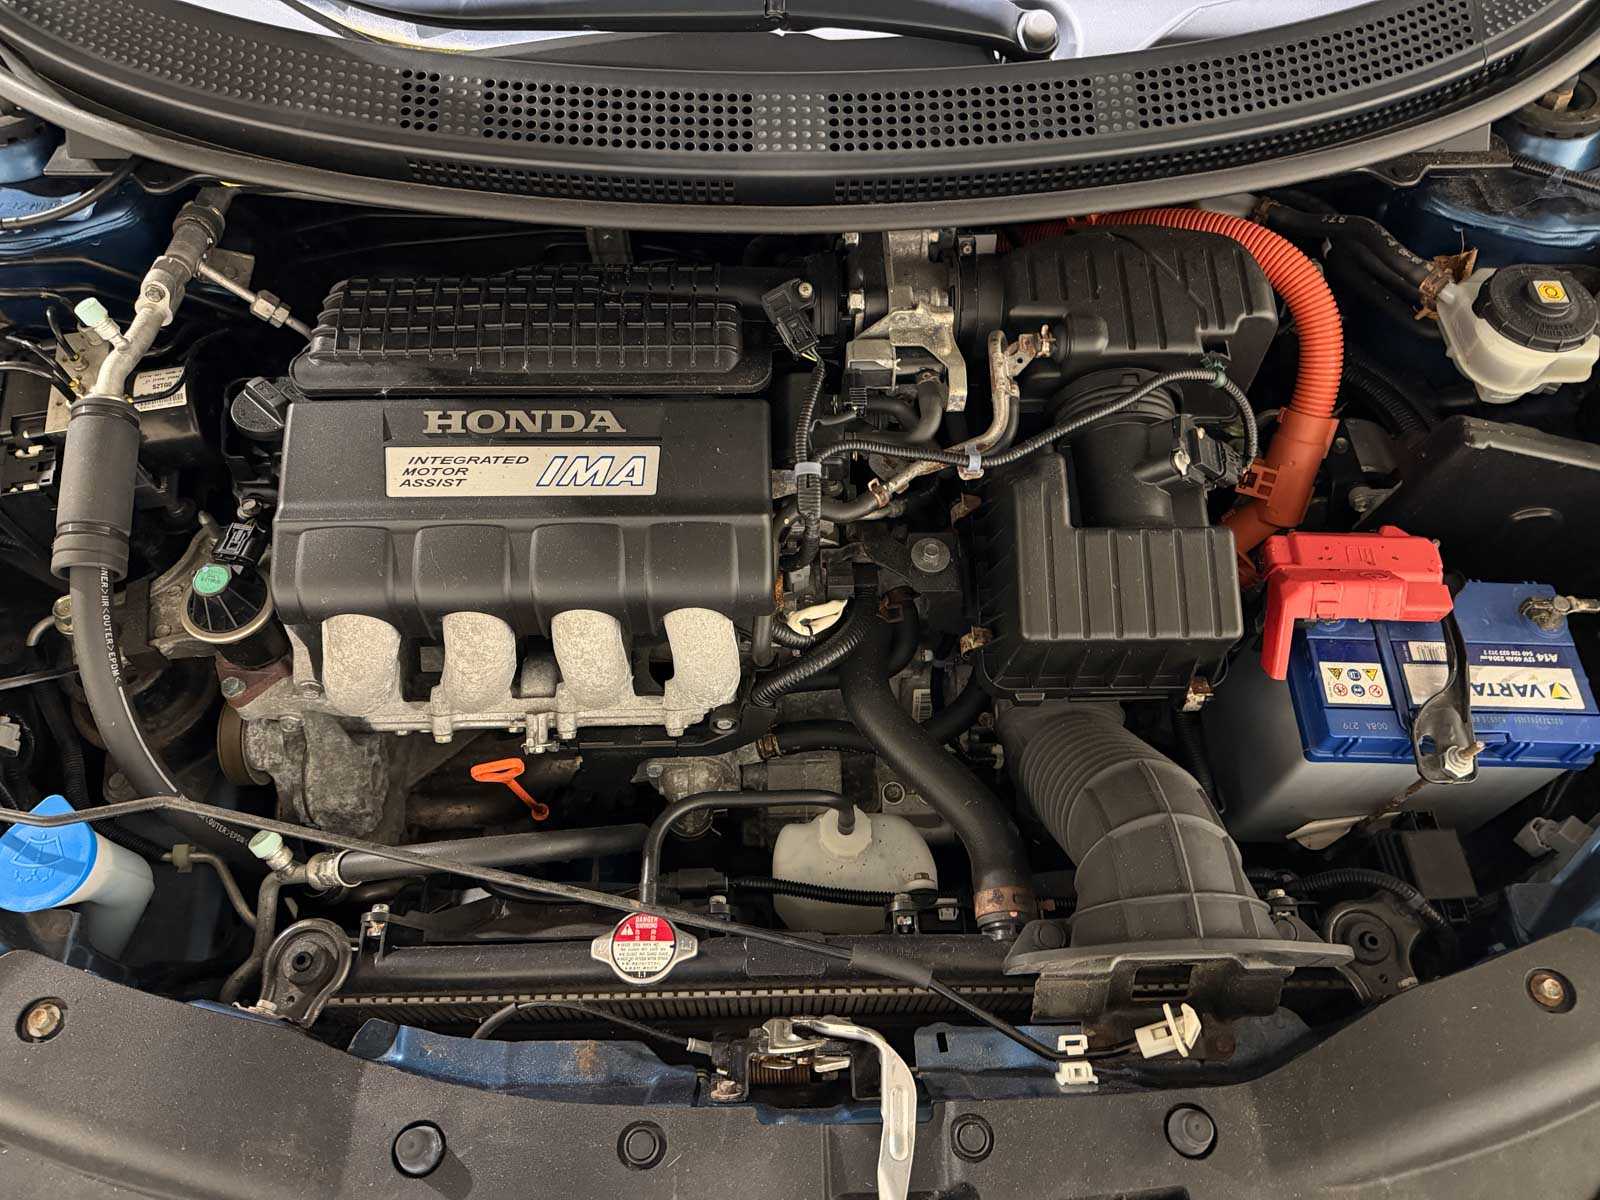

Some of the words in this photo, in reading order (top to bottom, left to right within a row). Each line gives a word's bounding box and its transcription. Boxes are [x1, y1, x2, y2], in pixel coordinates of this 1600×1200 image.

[423, 410, 626, 434] HONDA
[408, 455, 529, 465] INTEGRATED
[402, 466, 469, 476] MOTOR
[536, 455, 647, 487] IMA
[399, 477, 467, 488] ASSIST
[1535, 653, 1558, 663] A14
[1471, 682, 1546, 699] VARTA
